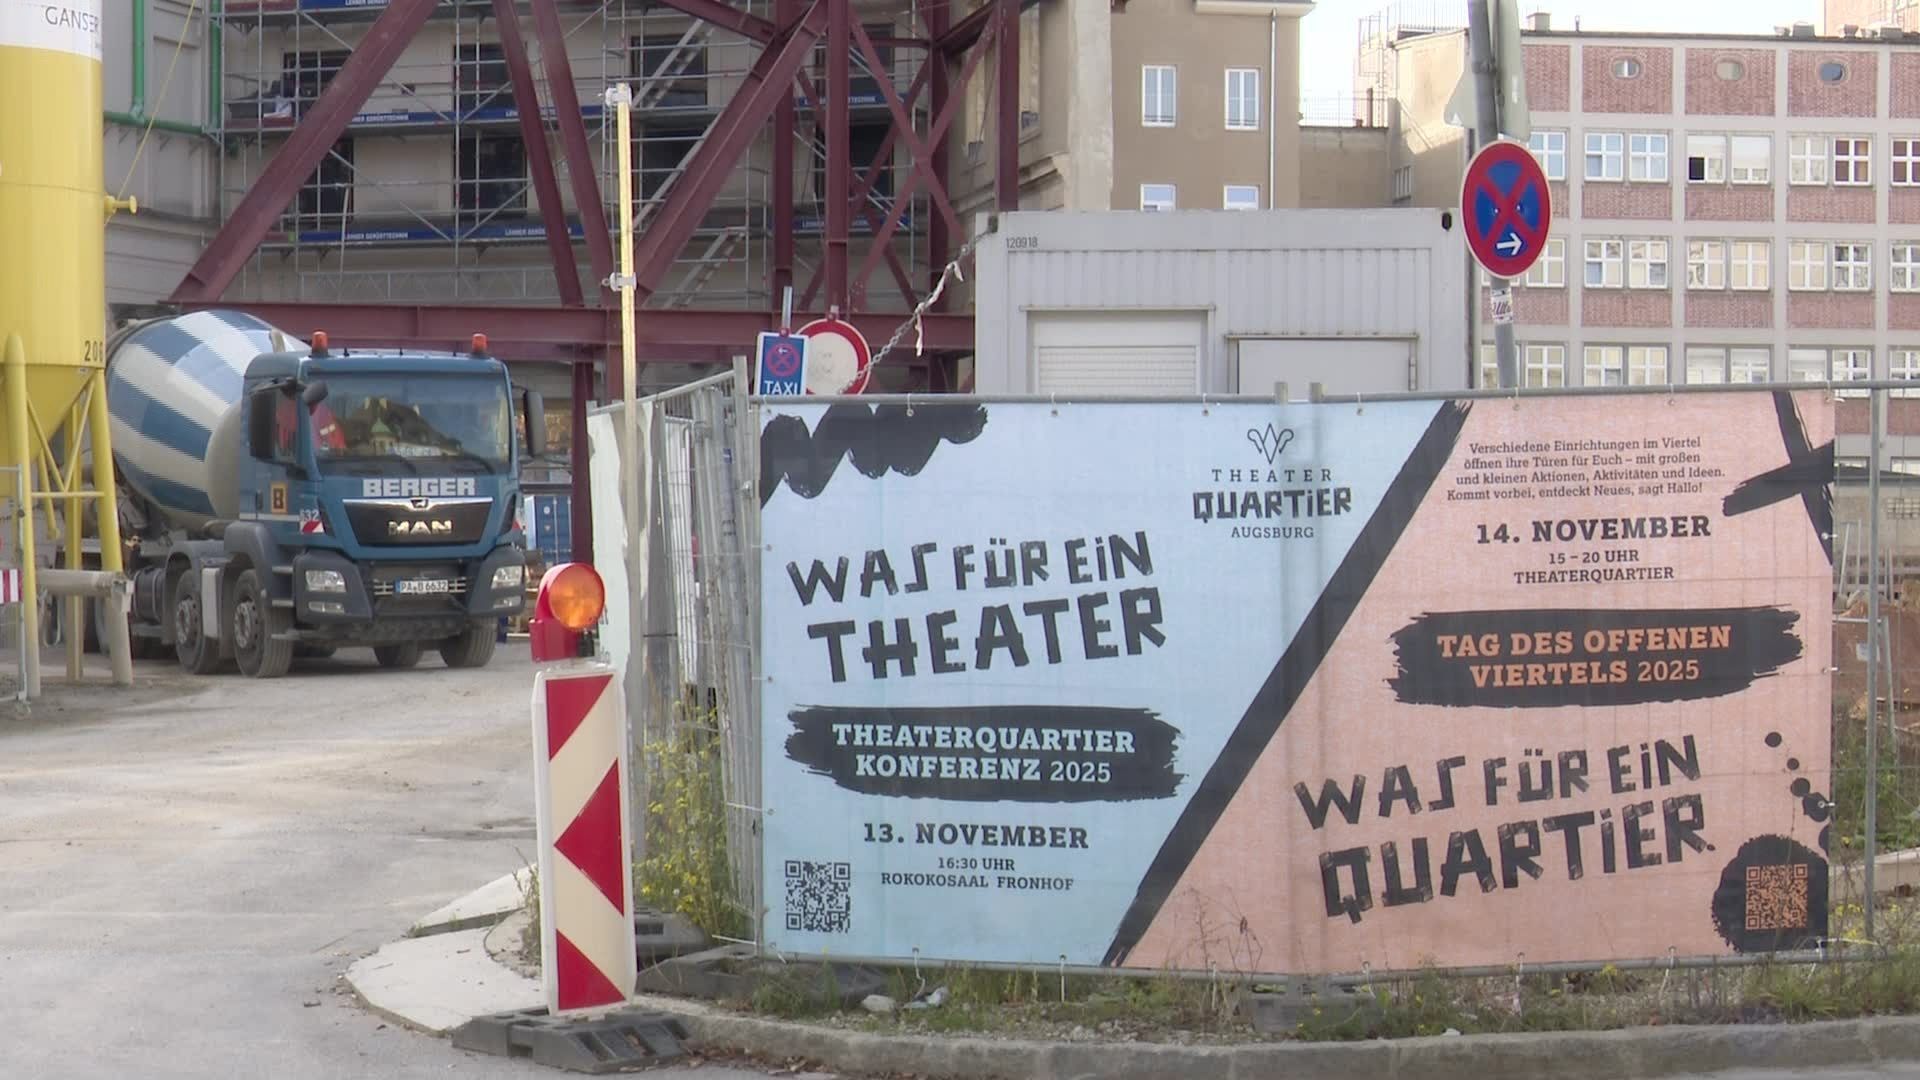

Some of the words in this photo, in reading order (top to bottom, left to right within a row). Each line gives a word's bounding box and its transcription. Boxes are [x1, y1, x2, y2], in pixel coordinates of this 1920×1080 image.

[765, 380, 798, 395] TAXI
[1469, 441, 1551, 454] Verschiedene
[1554, 439, 1640, 452] Einrichtungen
[1643, 437, 1658, 449] im
[1662, 436, 1701, 449] Viertel
[1464, 457, 1503, 470] öffnen
[1506, 457, 1529, 469] ihre
[1533, 456, 1568, 468] Türen
[1571, 455, 1589, 466] für
[1592, 454, 1622, 466] Euch
[1636, 453, 1655, 465] mit
[1658, 451, 1701, 466] großen
[1212, 469, 1332, 483] THEATER
[1456, 473, 1479, 485] und
[1483, 472, 1527, 484] kleinen
[1531, 470, 1589, 483] Aktionen,
[1593, 469, 1659, 481] Aktivitäten
[1662, 467, 1685, 479] und
[1689, 467, 1726, 478] Ideen.
[363, 479, 475, 496] BERGER
[1447, 489, 1490, 501] Kommt
[1493, 487, 1535, 500] vorbei,
[1539, 485, 1590, 498] entdeckt
[1594, 484, 1635, 497] Neues,
[1638, 483, 1664, 496] sagt
[1667, 482, 1703, 494] Hallo!
[388, 520, 452, 535] MAN
[1231, 526, 1314, 539] AUGSBURG
[1476, 523, 1520, 544] 14.
[1532, 515, 1711, 543] NOVEMBER
[1549, 552, 1565, 565] 15
[1582, 552, 1600, 564] 20
[1605, 550, 1639, 563] UHR
[786, 541, 938, 606] WAS
[953, 537, 1050, 591] FÜR
[1514, 567, 1674, 584] THEATERQUARTIER
[807, 587, 1166, 683] THEATER
[1437, 633, 1500, 658] TAG
[1510, 630, 1574, 657] DES
[1583, 625, 1732, 655] OFFENEN
[1469, 660, 1628, 689] VIERTELS
[1637, 659, 1700, 682] 2025
[832, 723, 1136, 754] THEATERQUARTIER
[855, 755, 1041, 781] KONFERENZ
[1050, 760, 1112, 784] 2025
[1293, 755, 1466, 830] WAS
[1483, 747, 1590, 806] FÜR
[863, 822, 905, 844] 13.
[915, 822, 1089, 849] NOVEMBER
[937, 856, 978, 870] 16:30
[982, 856, 1015, 872] UHR
[880, 871, 989, 888] ROKOKOSAAL
[997, 875, 1074, 891] FRONHOF
